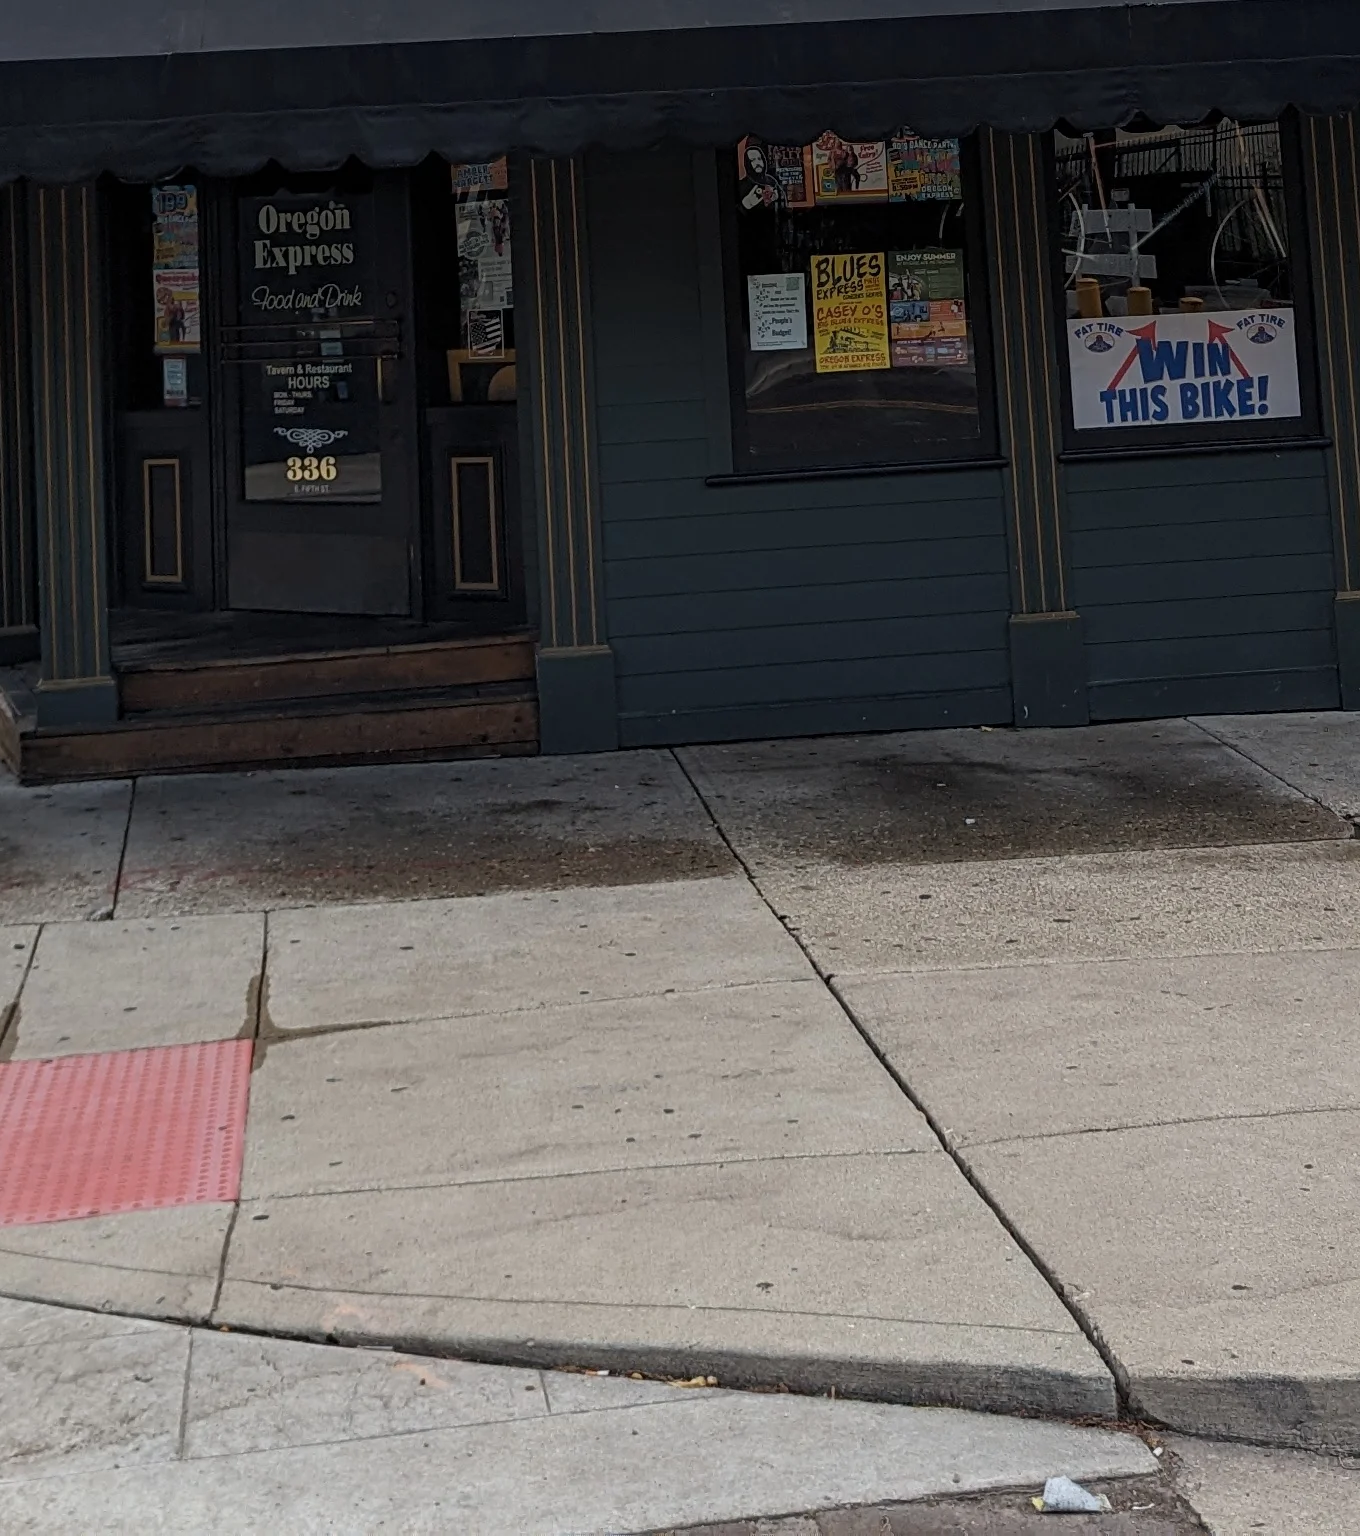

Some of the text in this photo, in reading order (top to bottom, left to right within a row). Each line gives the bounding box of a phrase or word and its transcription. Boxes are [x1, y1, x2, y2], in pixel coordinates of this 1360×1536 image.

[257, 202, 353, 241] Oregon
[252, 238, 356, 276] Express
[895, 251, 957, 263] ENJOY SUMMER
[814, 254, 882, 289] BLUES
[250, 282, 363, 311] Food and Drink
[815, 279, 864, 301] EXPRESS
[816, 304, 858, 321] CASEY
[861, 304, 885, 319] O'S
[1235, 312, 1287, 331] FAT TIRE
[1074, 321, 1125, 340] FAT TIRE
[265, 361, 354, 376] Tavern & Restaurant
[819, 352, 887, 365] OREGON EXPRESS
[1135, 337, 1232, 385] WIN
[287, 375, 331, 390] HOURS
[1100, 374, 1270, 424] THIS BIKE!
[285, 455, 338, 482] 336
